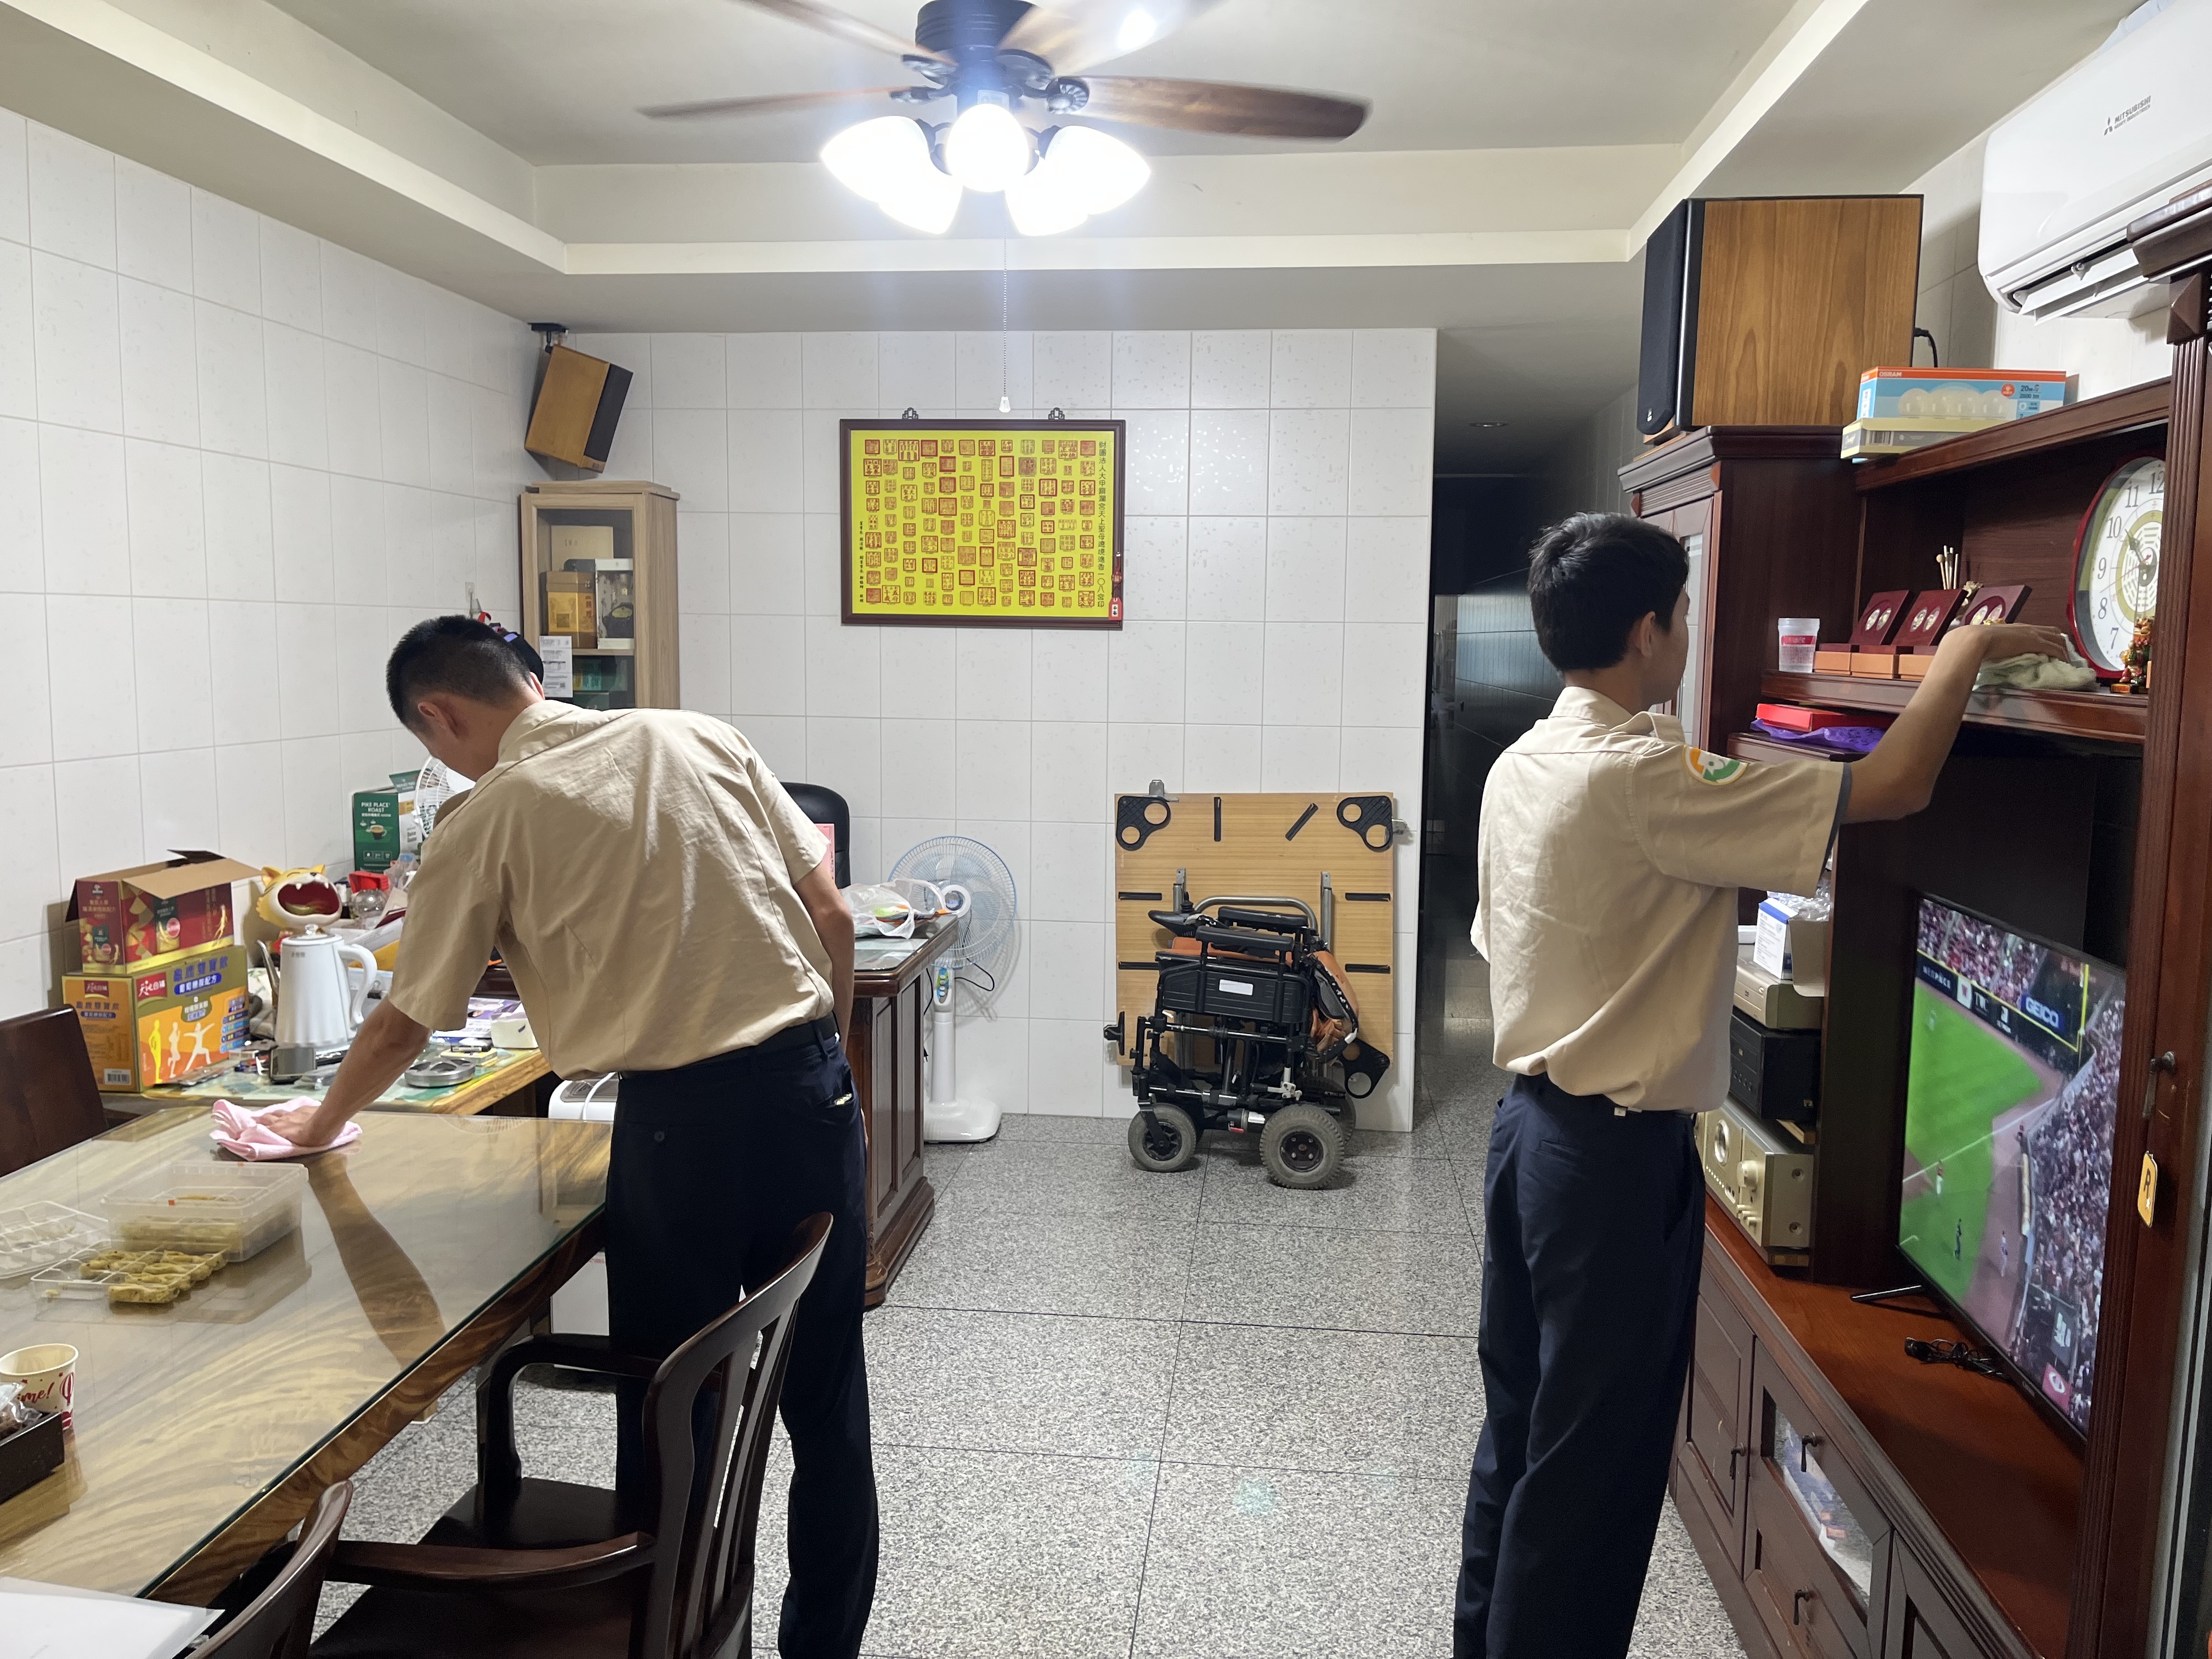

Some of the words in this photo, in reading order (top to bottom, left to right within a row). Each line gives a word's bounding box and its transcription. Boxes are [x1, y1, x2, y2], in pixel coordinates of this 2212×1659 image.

[2114, 95, 2151, 124] MITSUBISHI
[2148, 471, 2164, 495] 12
[2125, 483, 2139, 508] 11
[2106, 516, 2122, 539] 10
[2097, 557, 2107, 580] 9
[2098, 597, 2108, 619] 8
[2109, 627, 2119, 650] 7
[2025, 996, 2059, 1028] GEICO
